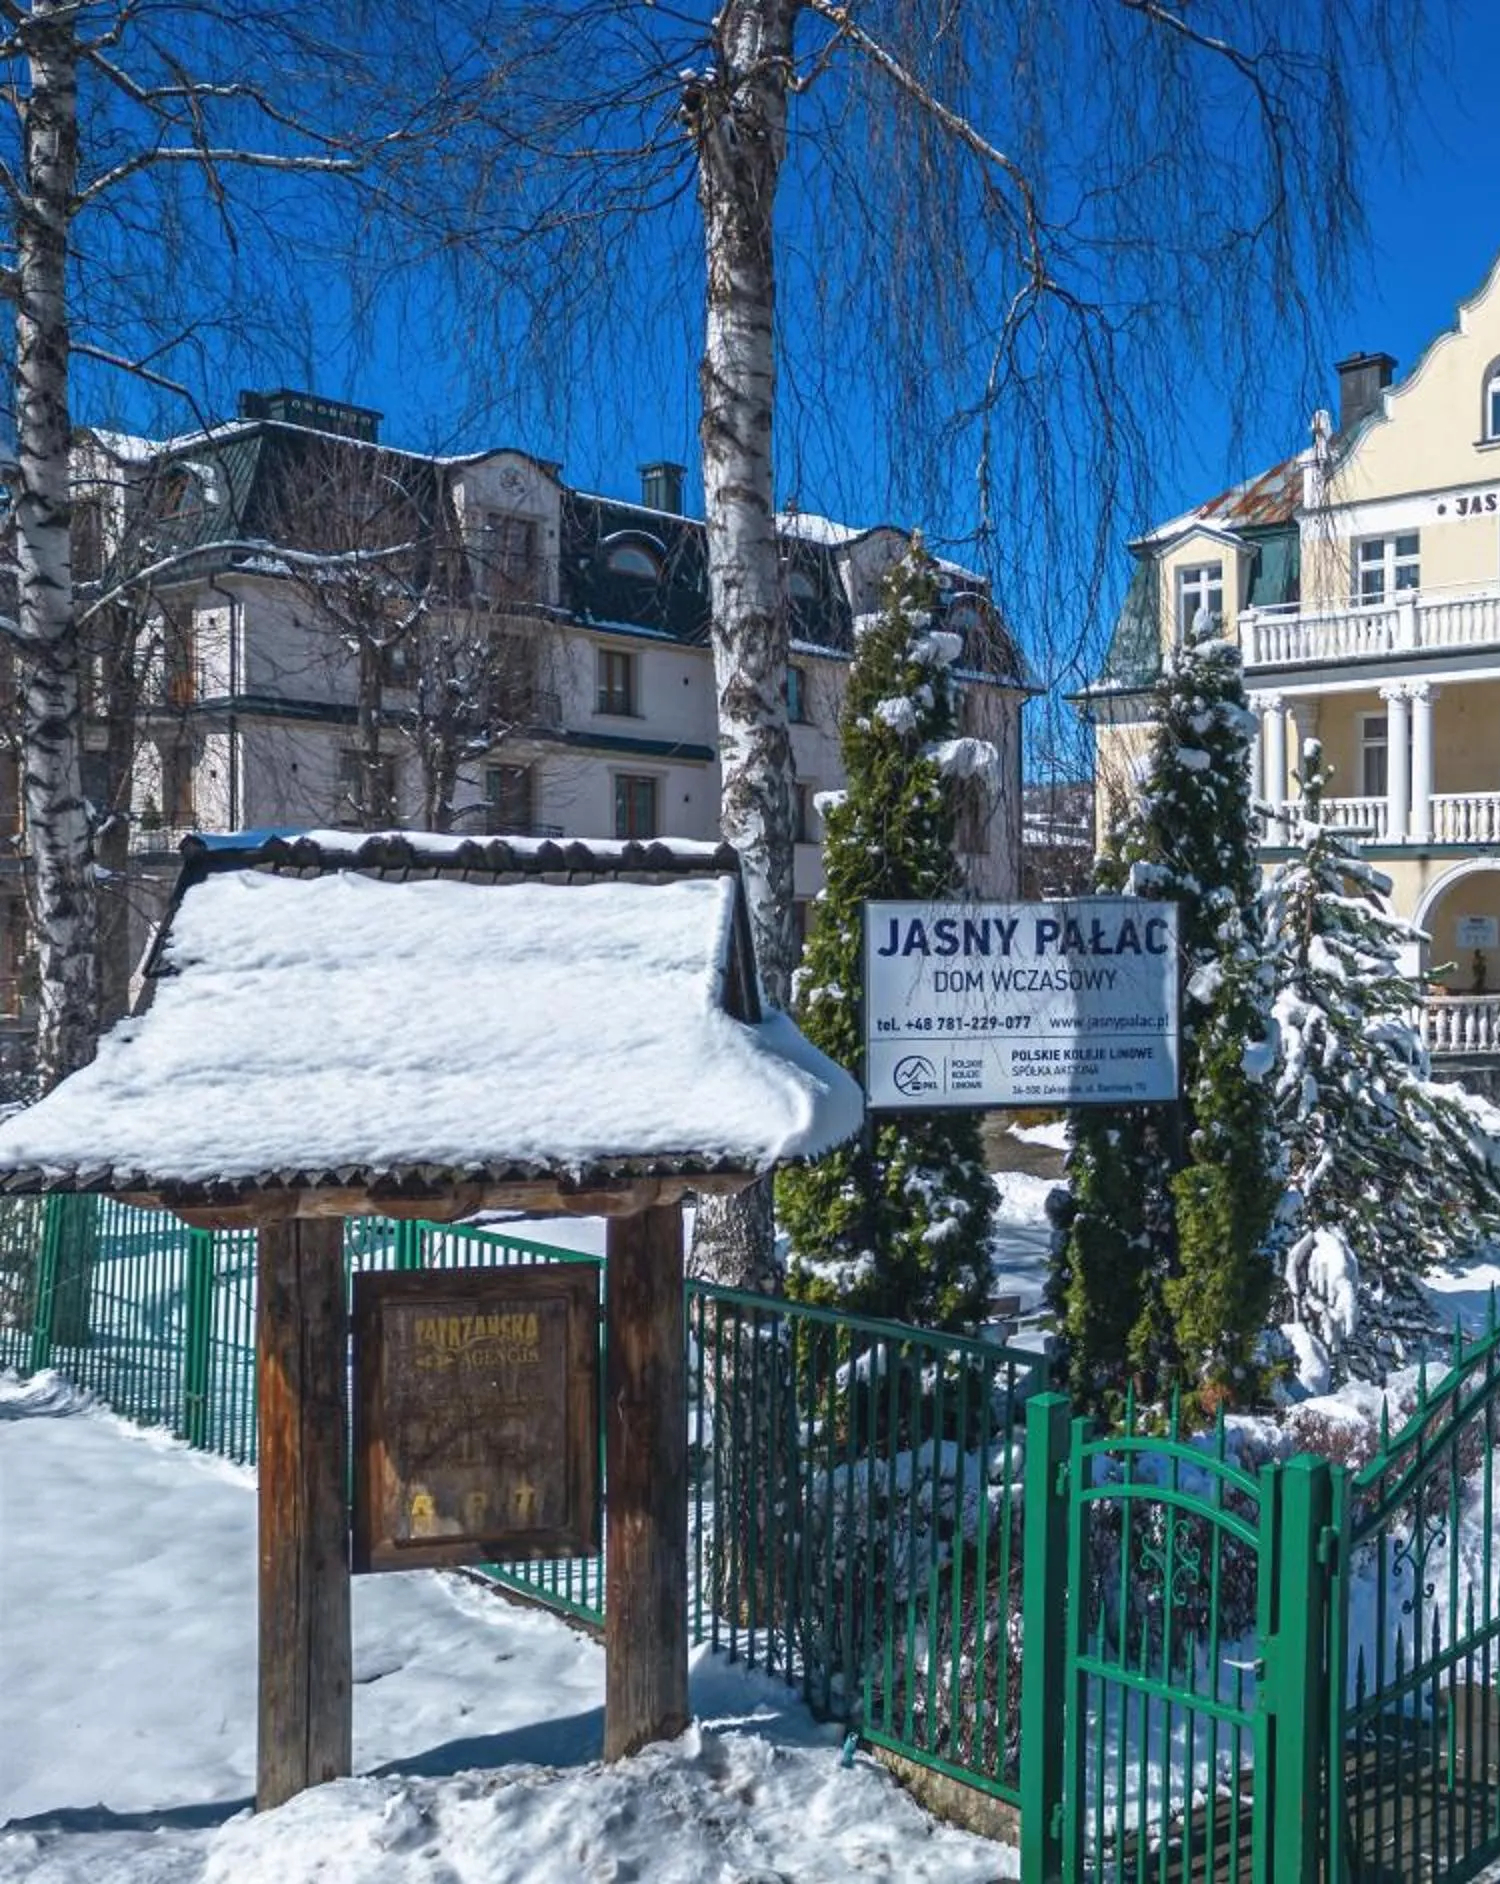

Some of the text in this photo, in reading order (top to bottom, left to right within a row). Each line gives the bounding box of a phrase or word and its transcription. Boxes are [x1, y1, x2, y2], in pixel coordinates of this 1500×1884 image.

[877, 917, 1168, 957] JASNY PAŁAC
[934, 969, 1116, 992] DOM WCZASOWY
[877, 1013, 1169, 1031] tel. +48 781-229-077 www.jasnypalac.pl
[1011, 1047, 1153, 1061] POLSKIE KOLEJE LINOWE
